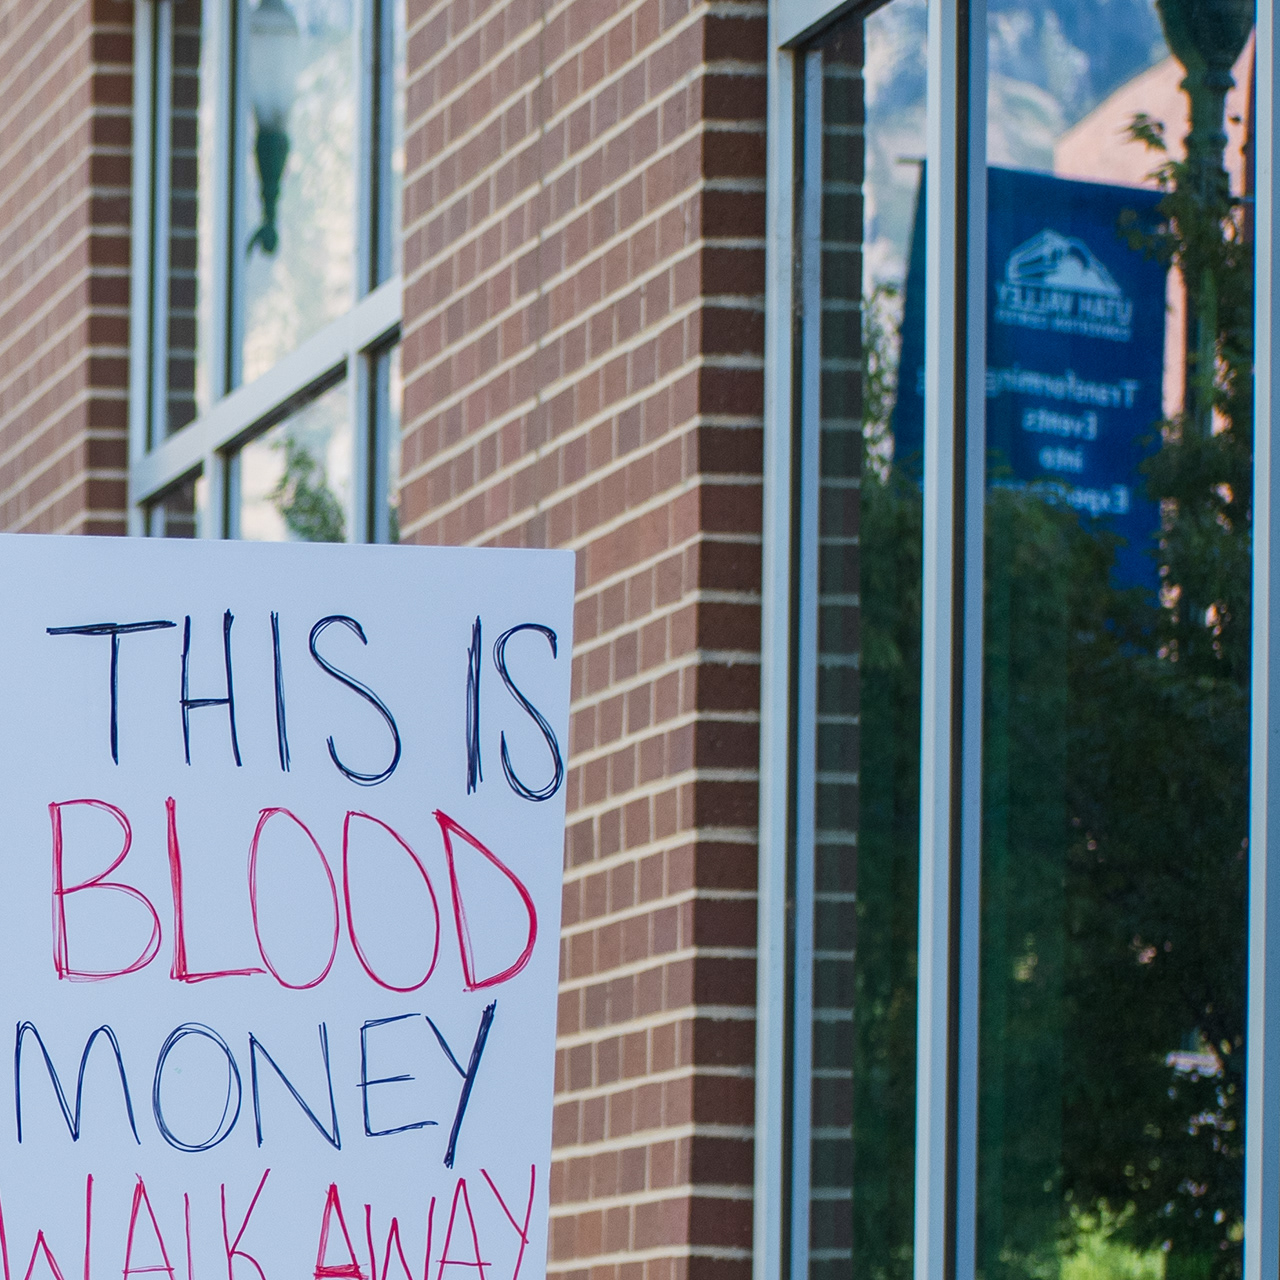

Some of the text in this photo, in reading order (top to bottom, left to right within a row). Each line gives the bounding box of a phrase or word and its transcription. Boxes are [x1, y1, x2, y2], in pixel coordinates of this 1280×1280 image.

[45, 608, 565, 803] THIS IS
[47, 796, 538, 993] BLOOD
[14, 999, 497, 1169] MONEY
